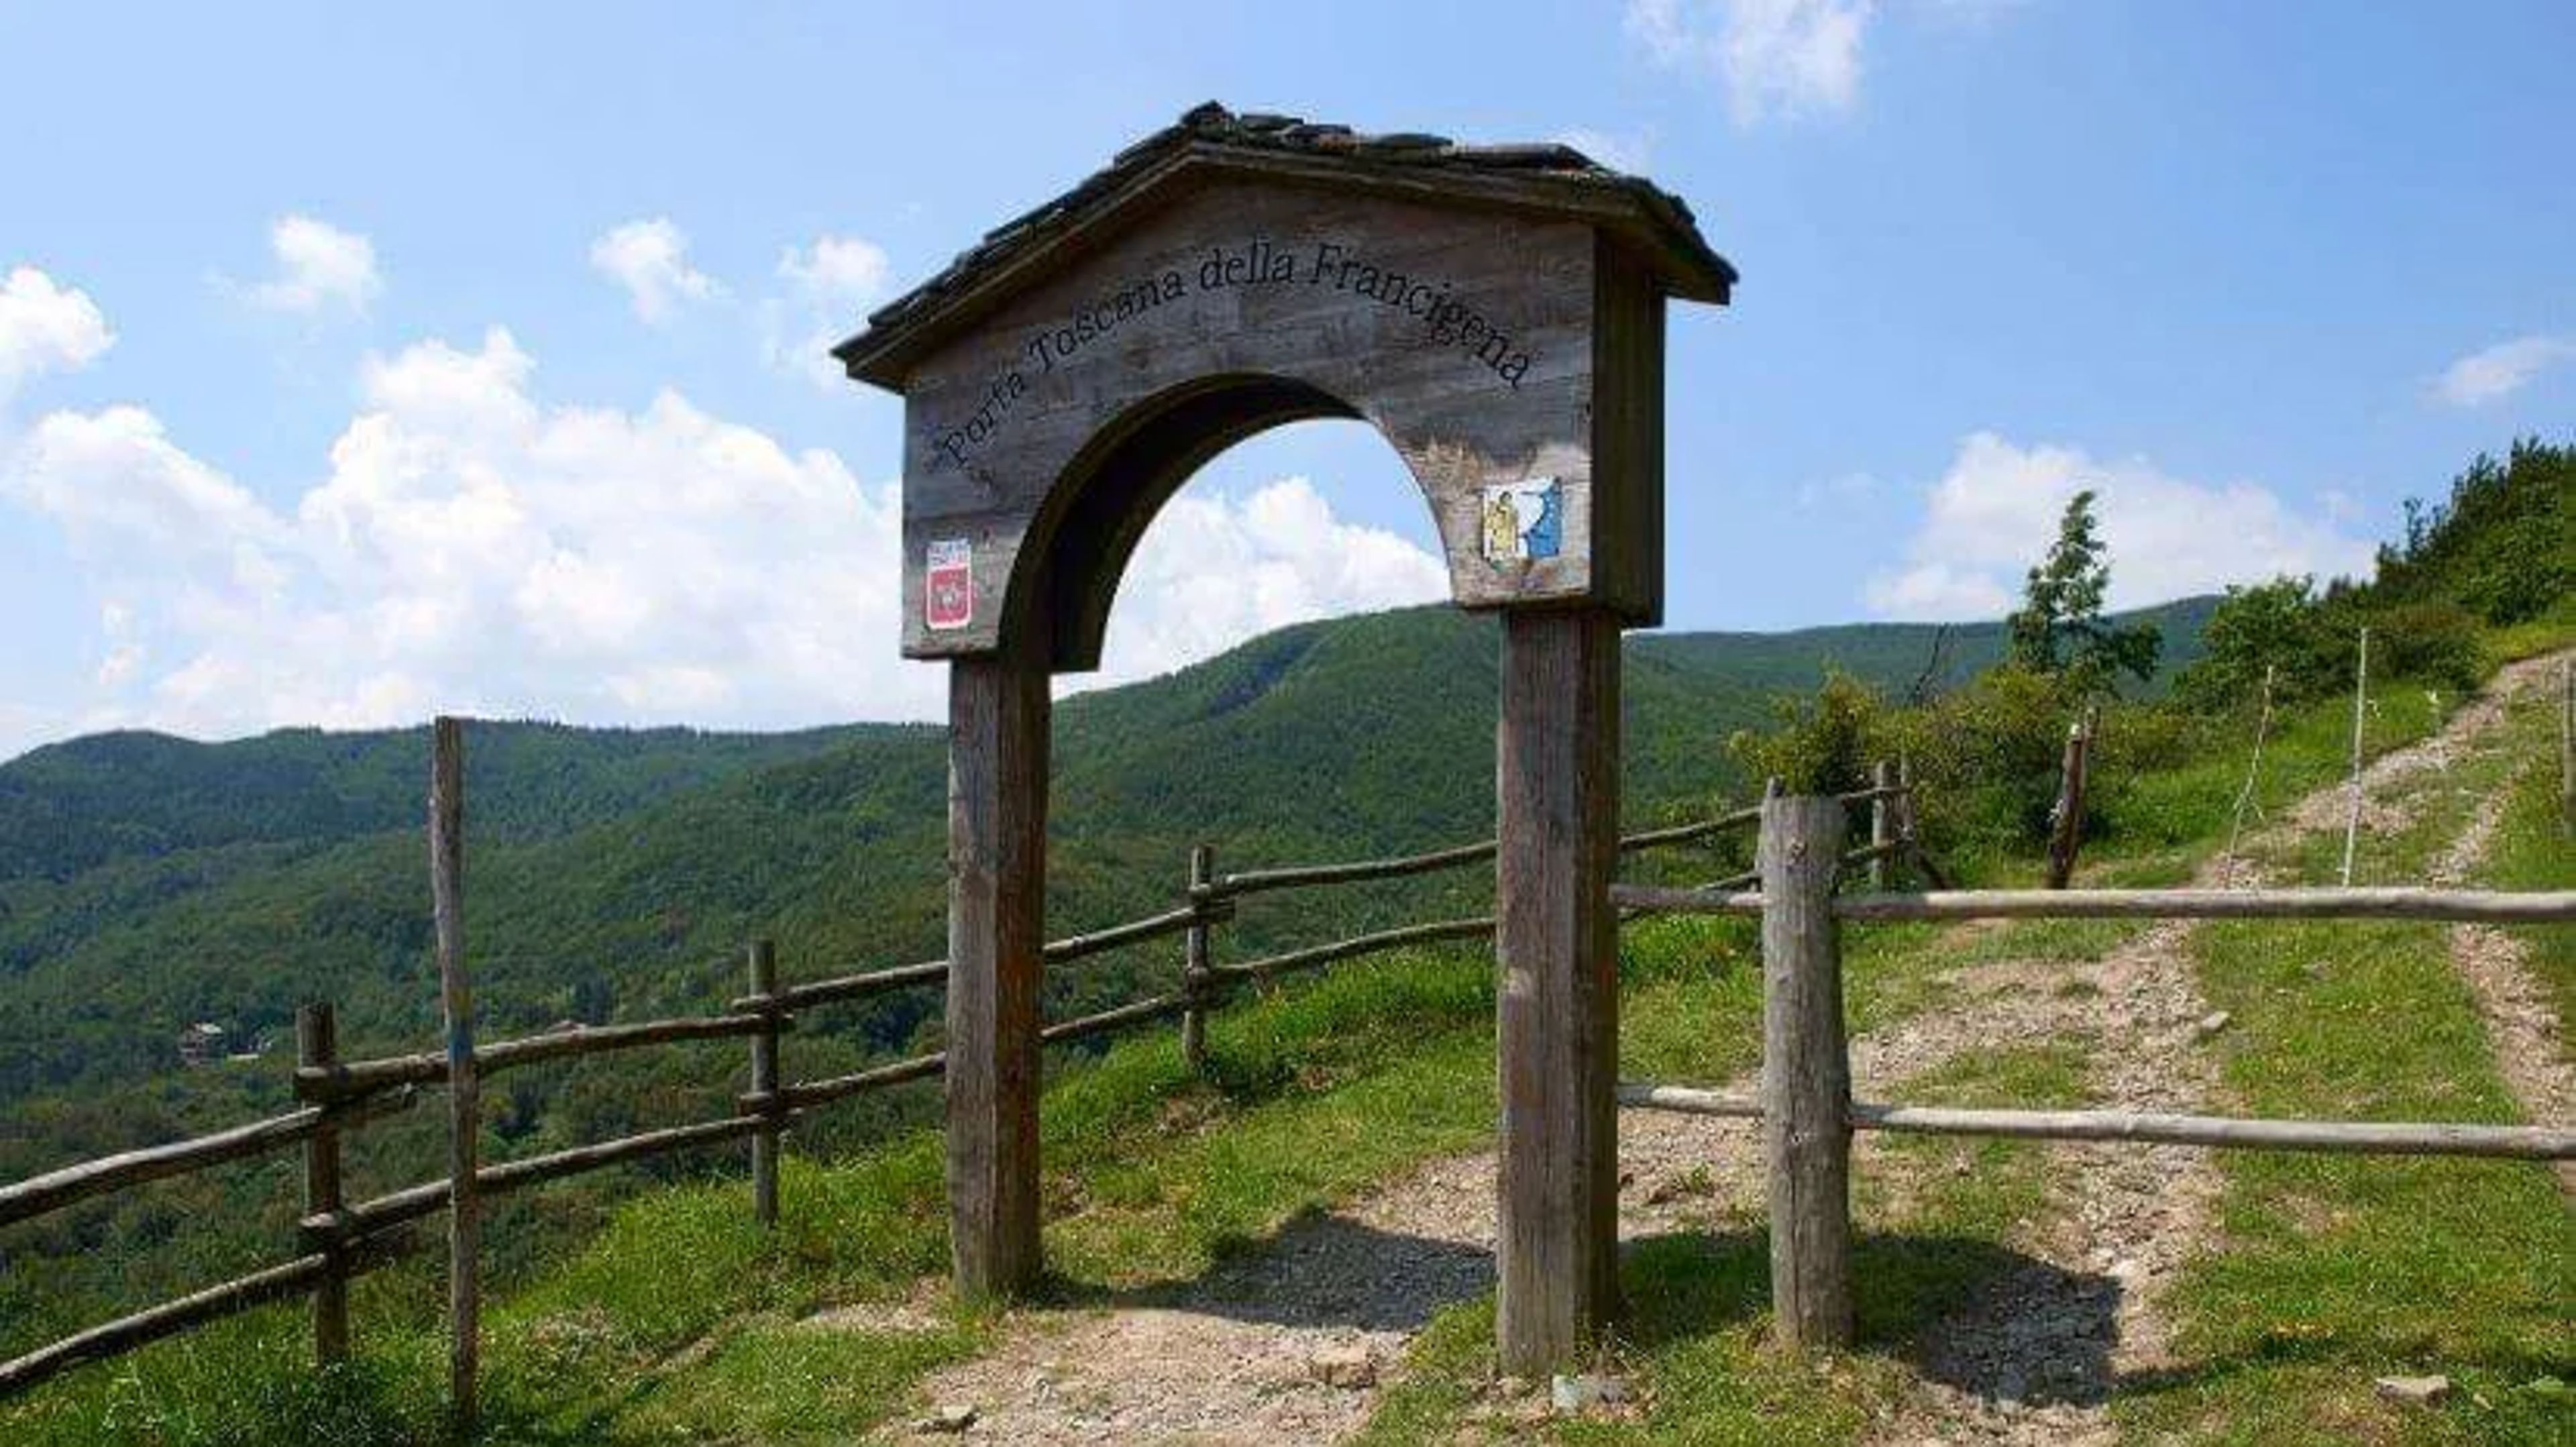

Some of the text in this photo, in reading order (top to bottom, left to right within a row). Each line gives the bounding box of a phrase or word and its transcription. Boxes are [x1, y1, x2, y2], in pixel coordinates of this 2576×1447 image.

[941, 242, 1531, 467] Porta Toscana della Francigena
